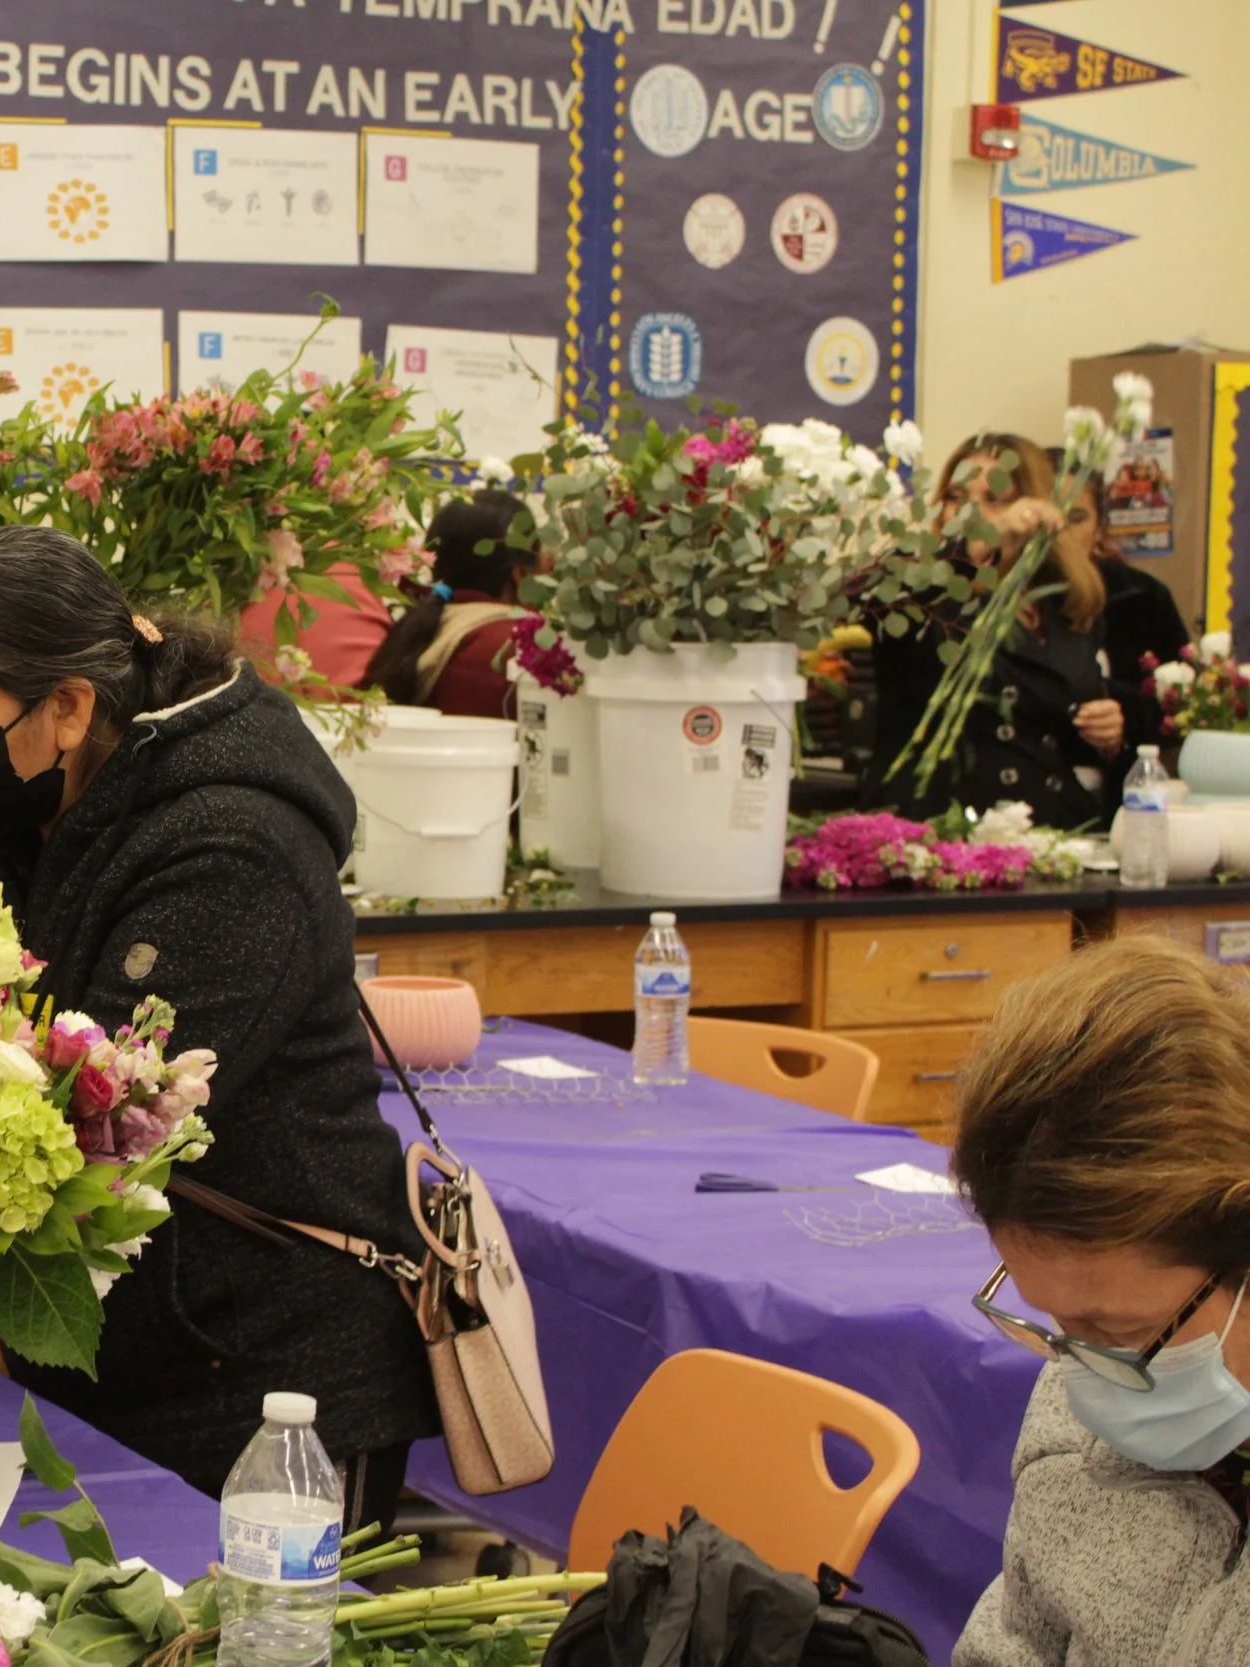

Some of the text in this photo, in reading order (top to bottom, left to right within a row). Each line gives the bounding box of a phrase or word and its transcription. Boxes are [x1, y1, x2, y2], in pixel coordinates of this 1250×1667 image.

[657, 0, 795, 39] EDAD
[1076, 44, 1108, 89] SF
[224, 59, 300, 113] AT
[306, 64, 386, 119] AN
[405, 71, 581, 131] EARLY
[707, 89, 815, 143] AGE
[1, 147, 12, 167] E
[198, 152, 211, 172] F
[1009, 123, 1158, 188] COLUMBIA
[203, 335, 217, 357] F
